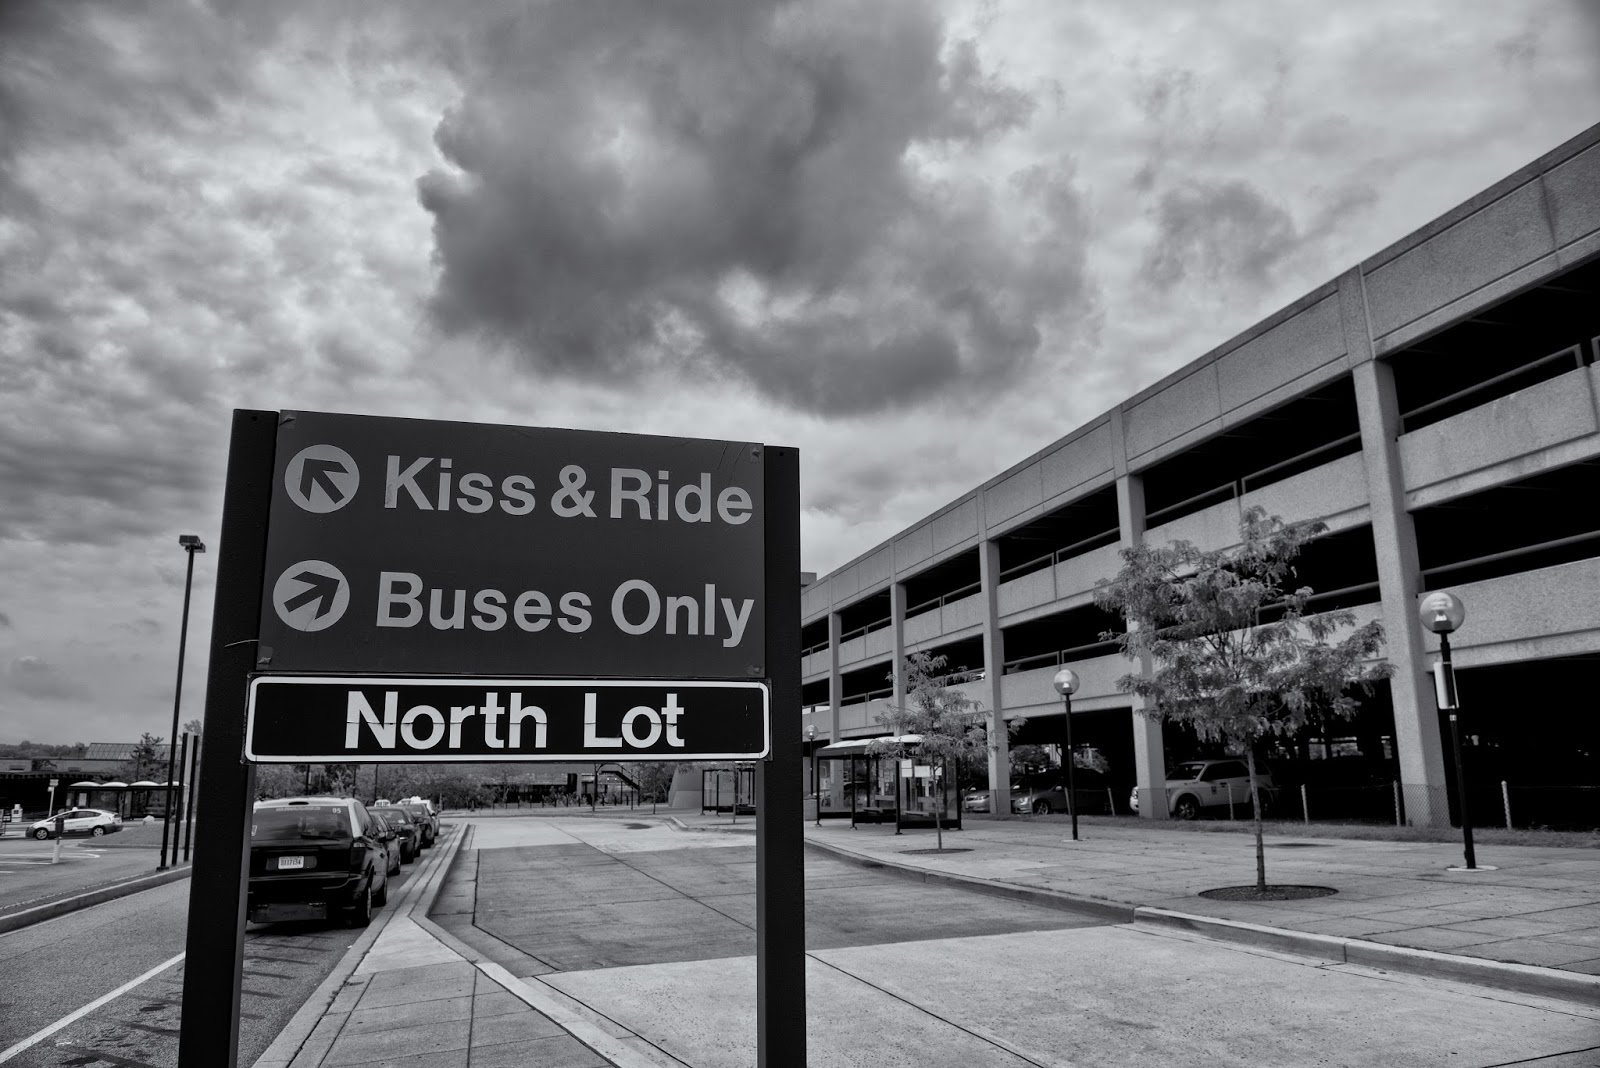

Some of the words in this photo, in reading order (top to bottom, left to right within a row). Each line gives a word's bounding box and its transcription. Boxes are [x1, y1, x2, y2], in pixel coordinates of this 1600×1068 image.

[385, 456, 535, 516] Kiss
[551, 465, 597, 518] &
[611, 468, 753, 525] Ride
[377, 572, 592, 634] Buses
[612, 580, 754, 648] Only
[345, 691, 547, 749] North
[584, 692, 685, 749] Lot
